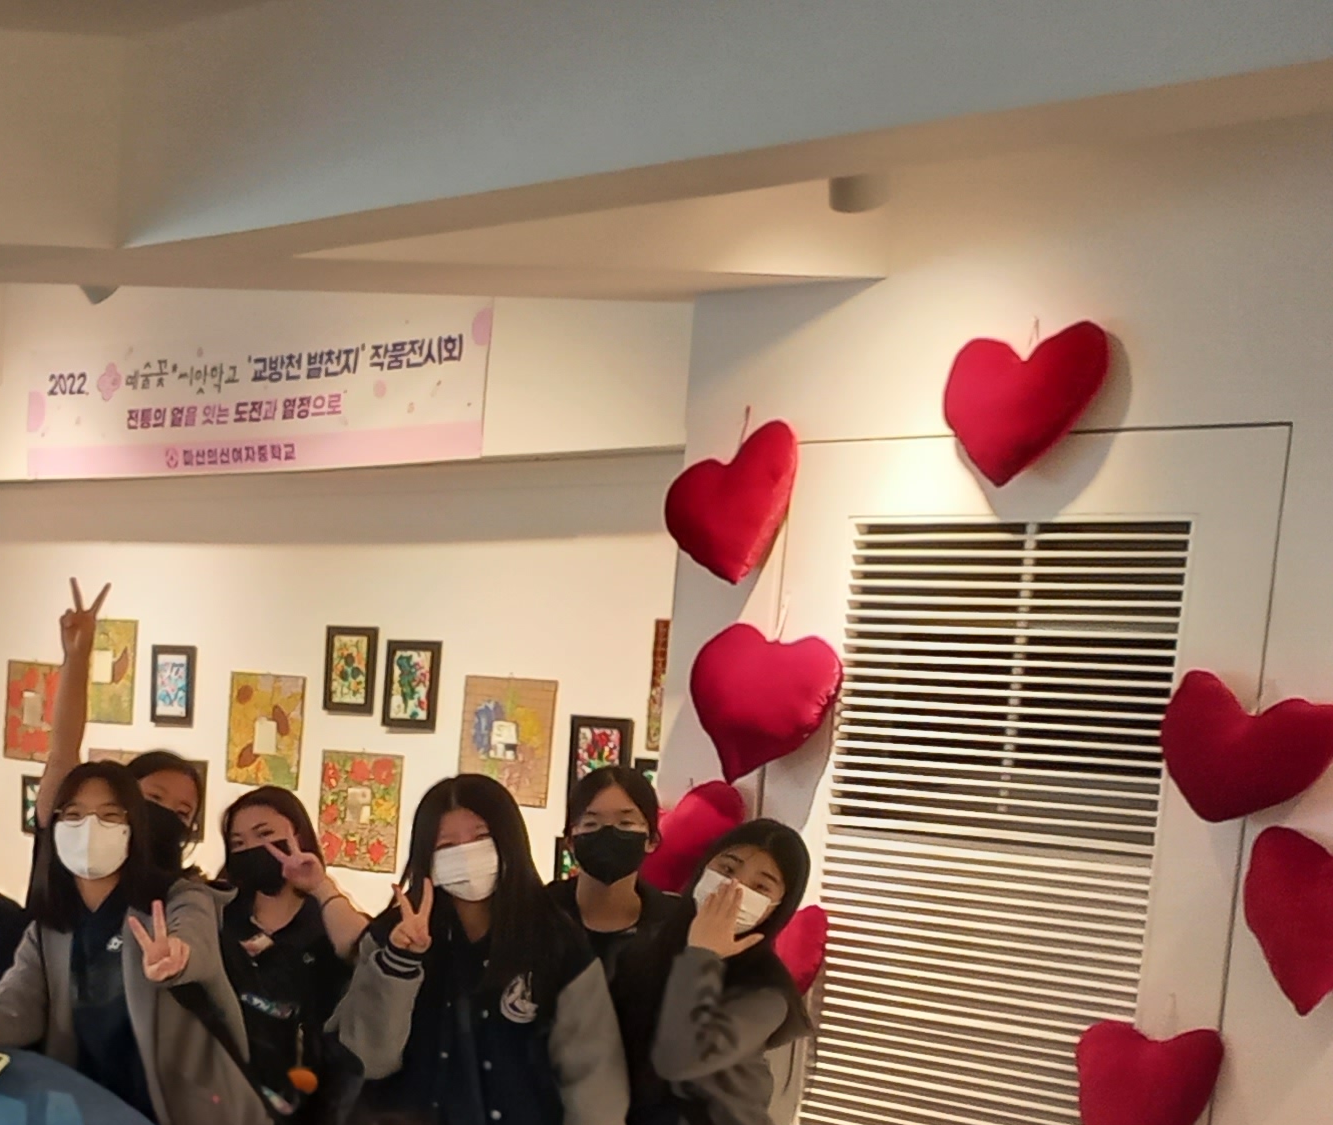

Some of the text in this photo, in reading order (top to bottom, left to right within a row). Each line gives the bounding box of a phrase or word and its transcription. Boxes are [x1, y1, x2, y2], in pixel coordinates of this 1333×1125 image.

[48, 372, 87, 396] 2022
[369, 333, 463, 371] 작품전시회
[126, 393, 342, 430] 전통의 얼을 잇는 도전과 열정으로
